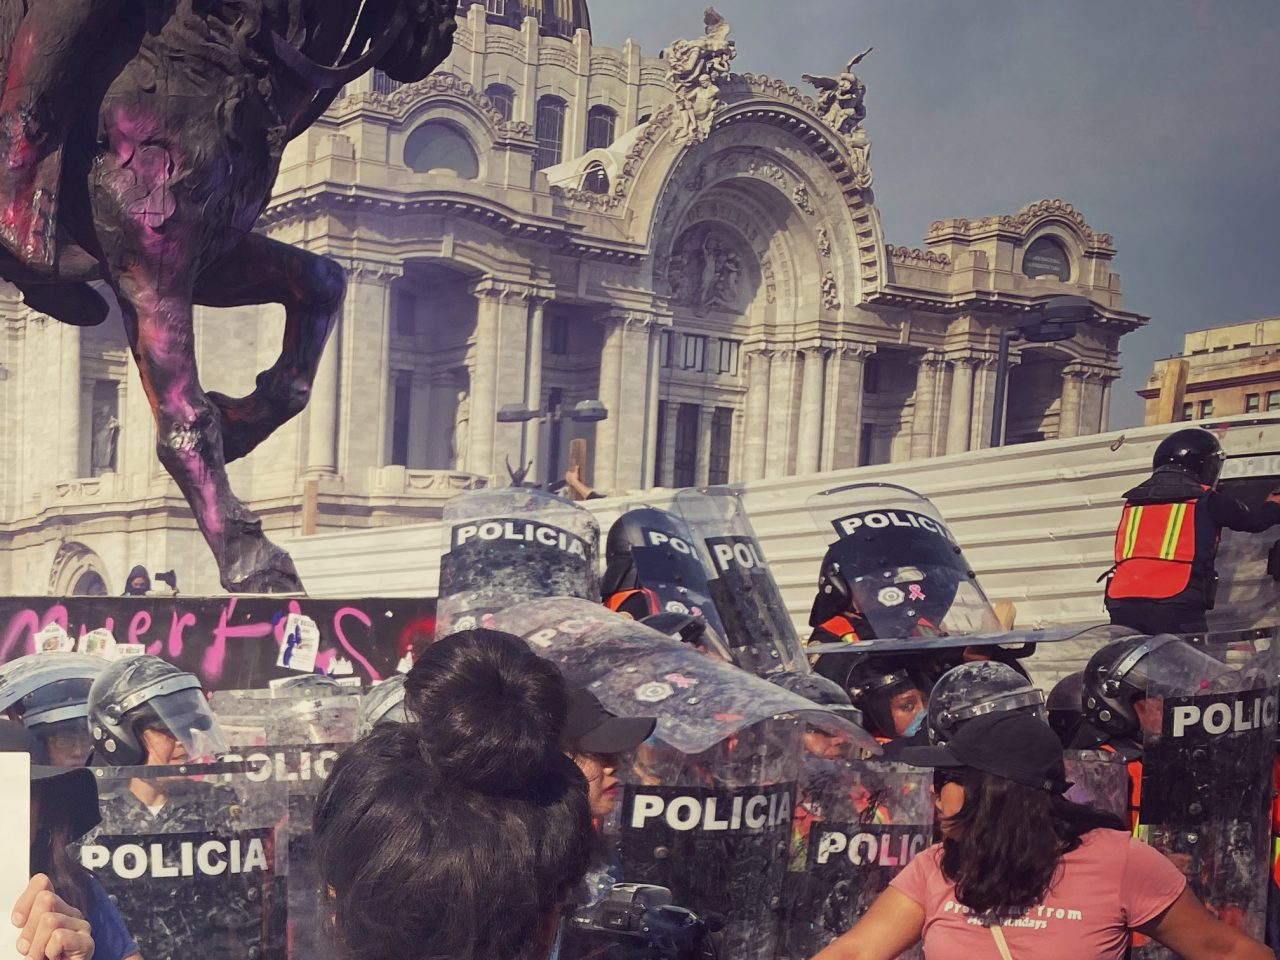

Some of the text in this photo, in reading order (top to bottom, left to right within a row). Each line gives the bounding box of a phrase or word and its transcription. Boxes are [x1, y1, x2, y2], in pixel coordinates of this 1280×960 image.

[756, 249, 778, 305] ARTES
[456, 521, 587, 561] POLICIA
[632, 791, 791, 834] POLICIA
[80, 837, 269, 880] POLICIA
